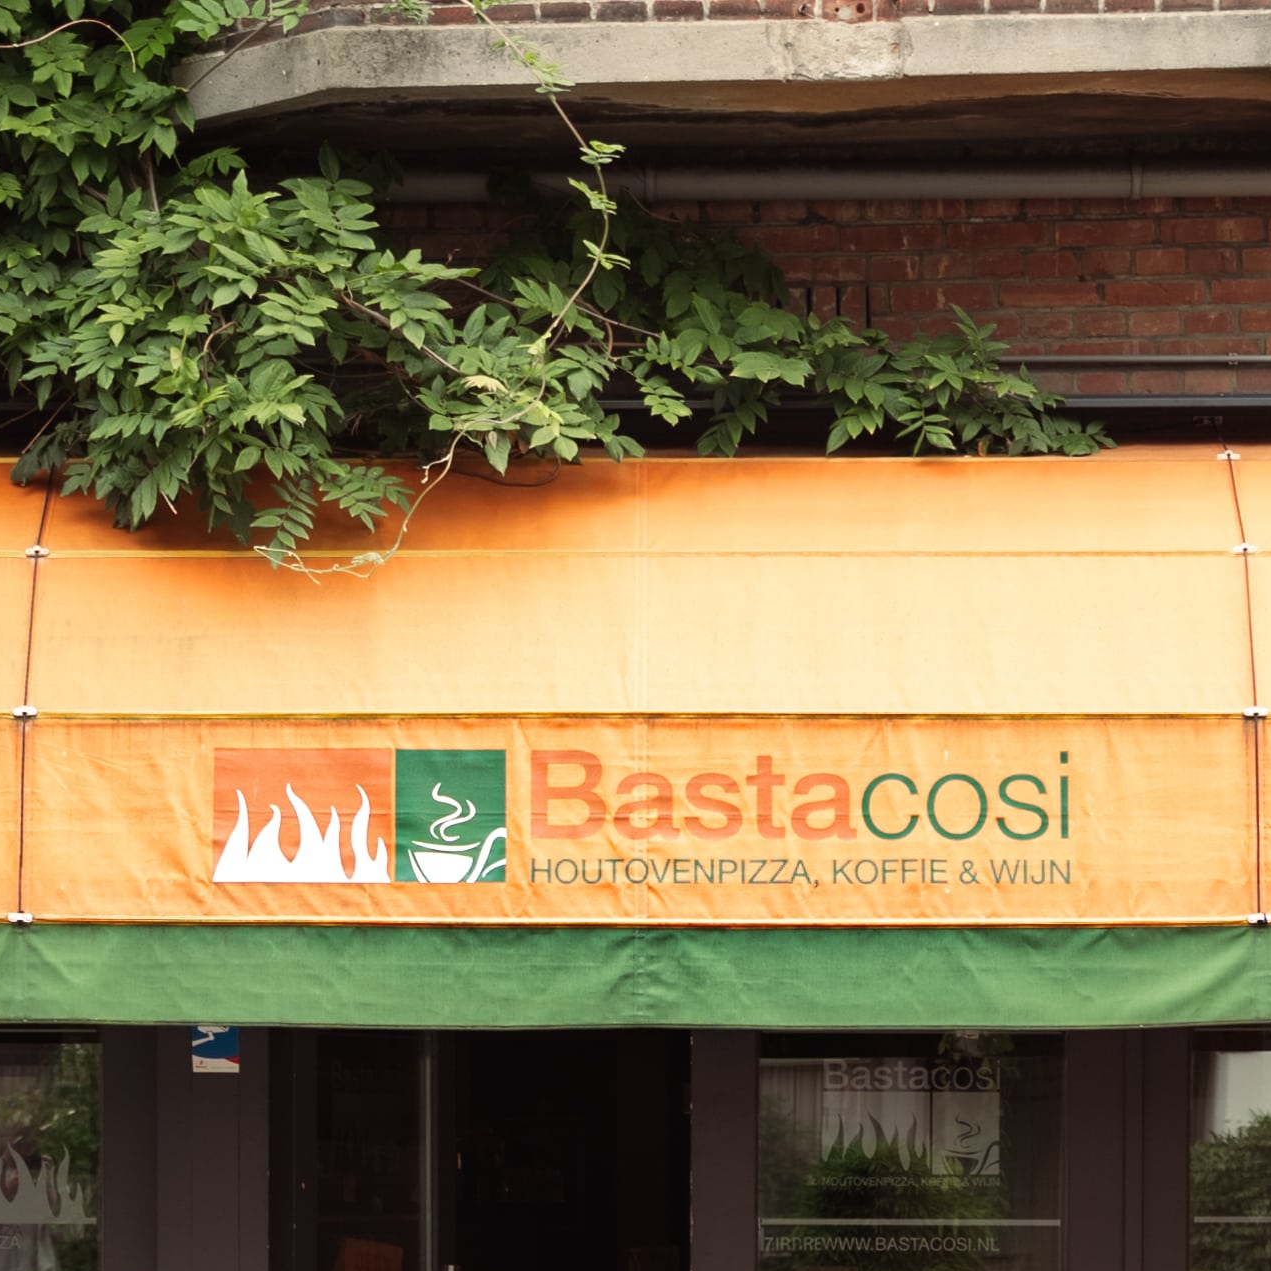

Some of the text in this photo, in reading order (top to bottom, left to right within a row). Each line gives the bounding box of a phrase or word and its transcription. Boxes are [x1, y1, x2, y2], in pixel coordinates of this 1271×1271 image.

[530, 749, 1070, 841] Bastacosi
[530, 858, 1071, 888] HOUTOVENPIZZA, KOFFIE & WIJN
[823, 1058, 1001, 1091] Bastacosi
[822, 1236, 1001, 1251] WWW.BASTACOSI.NL
